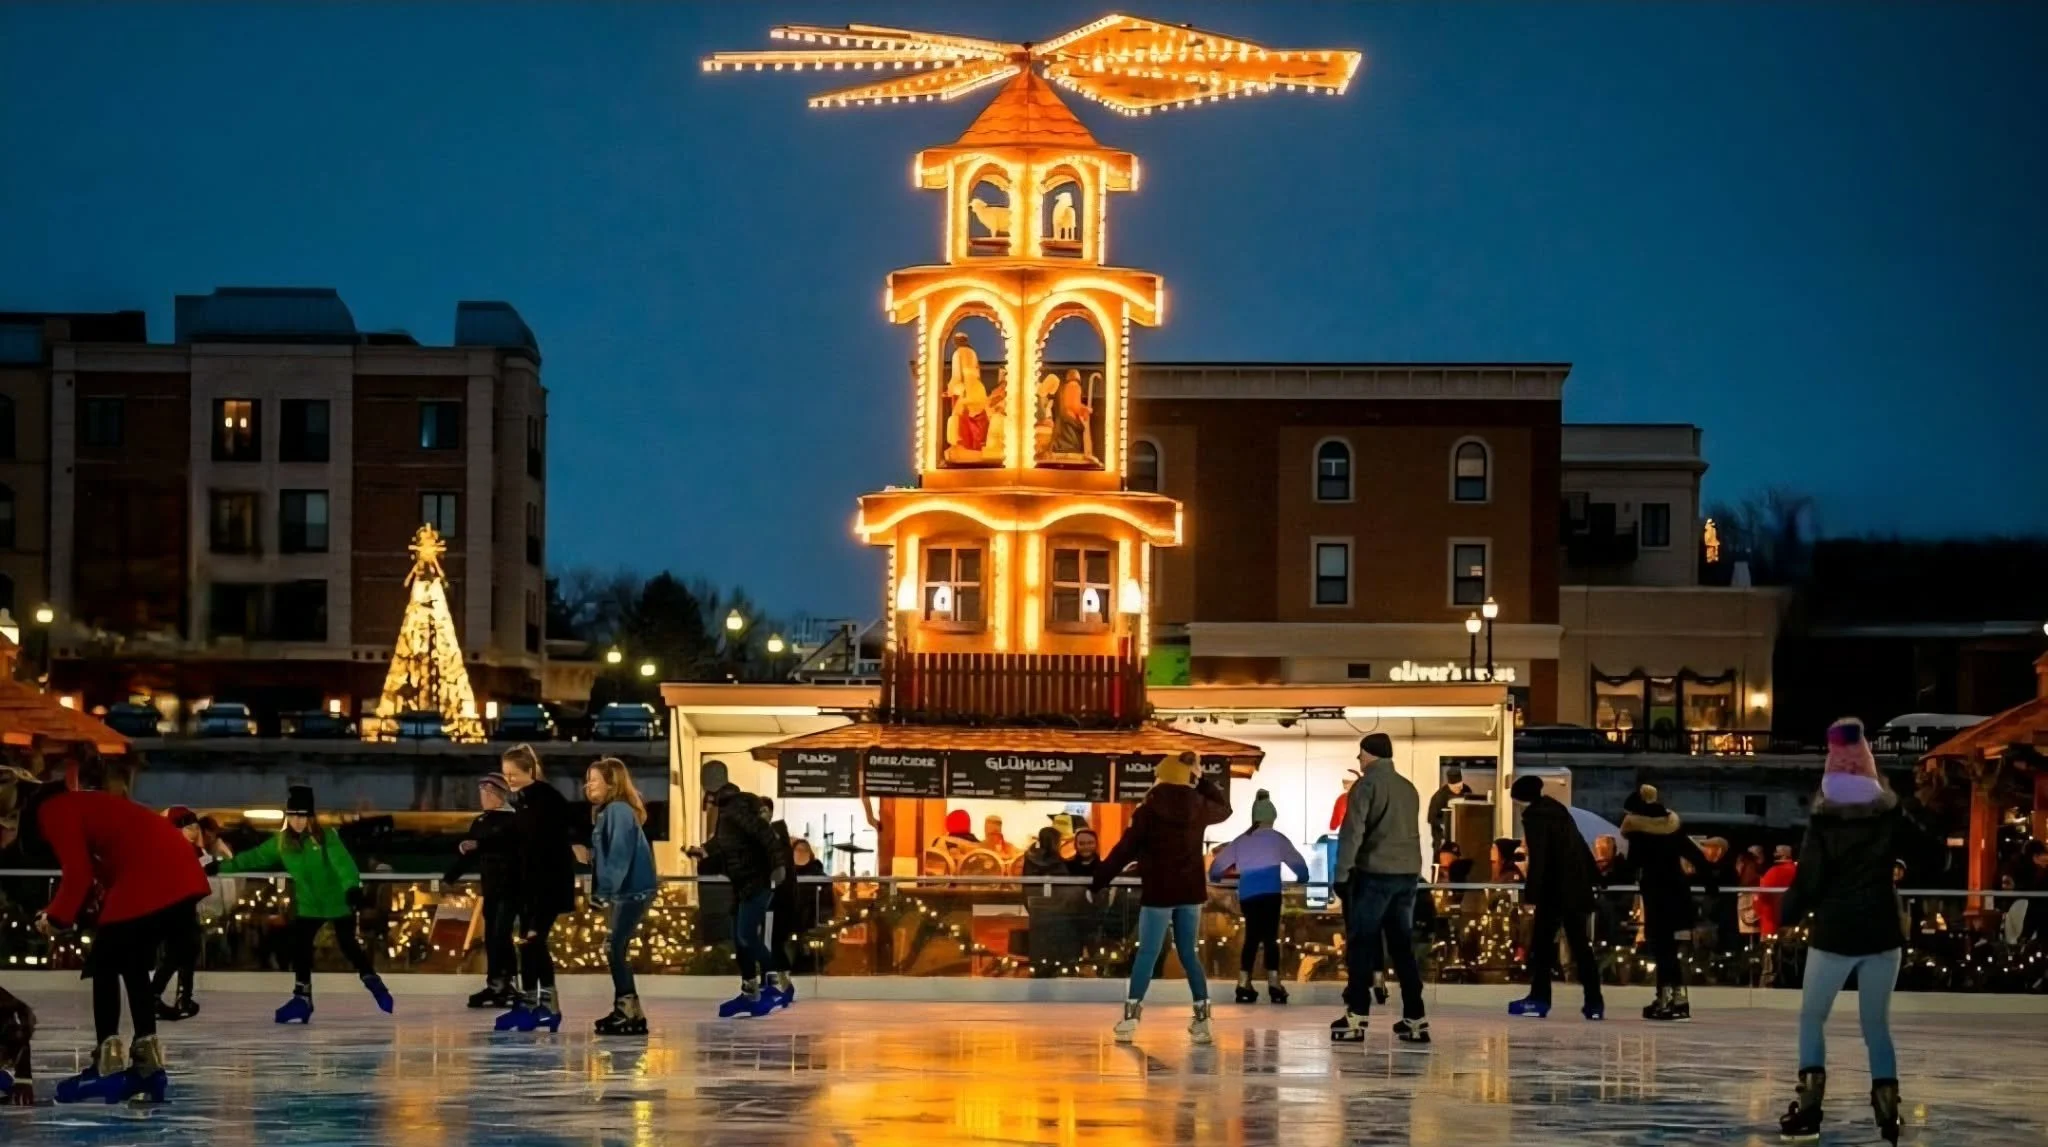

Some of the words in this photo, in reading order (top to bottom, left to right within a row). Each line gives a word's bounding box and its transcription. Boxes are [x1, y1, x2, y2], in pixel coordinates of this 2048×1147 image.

[797, 753, 837, 764] PUNCH
[869, 754, 937, 767] BEER/CIDER
[985, 756, 1074, 772] GLÜHWEIN
